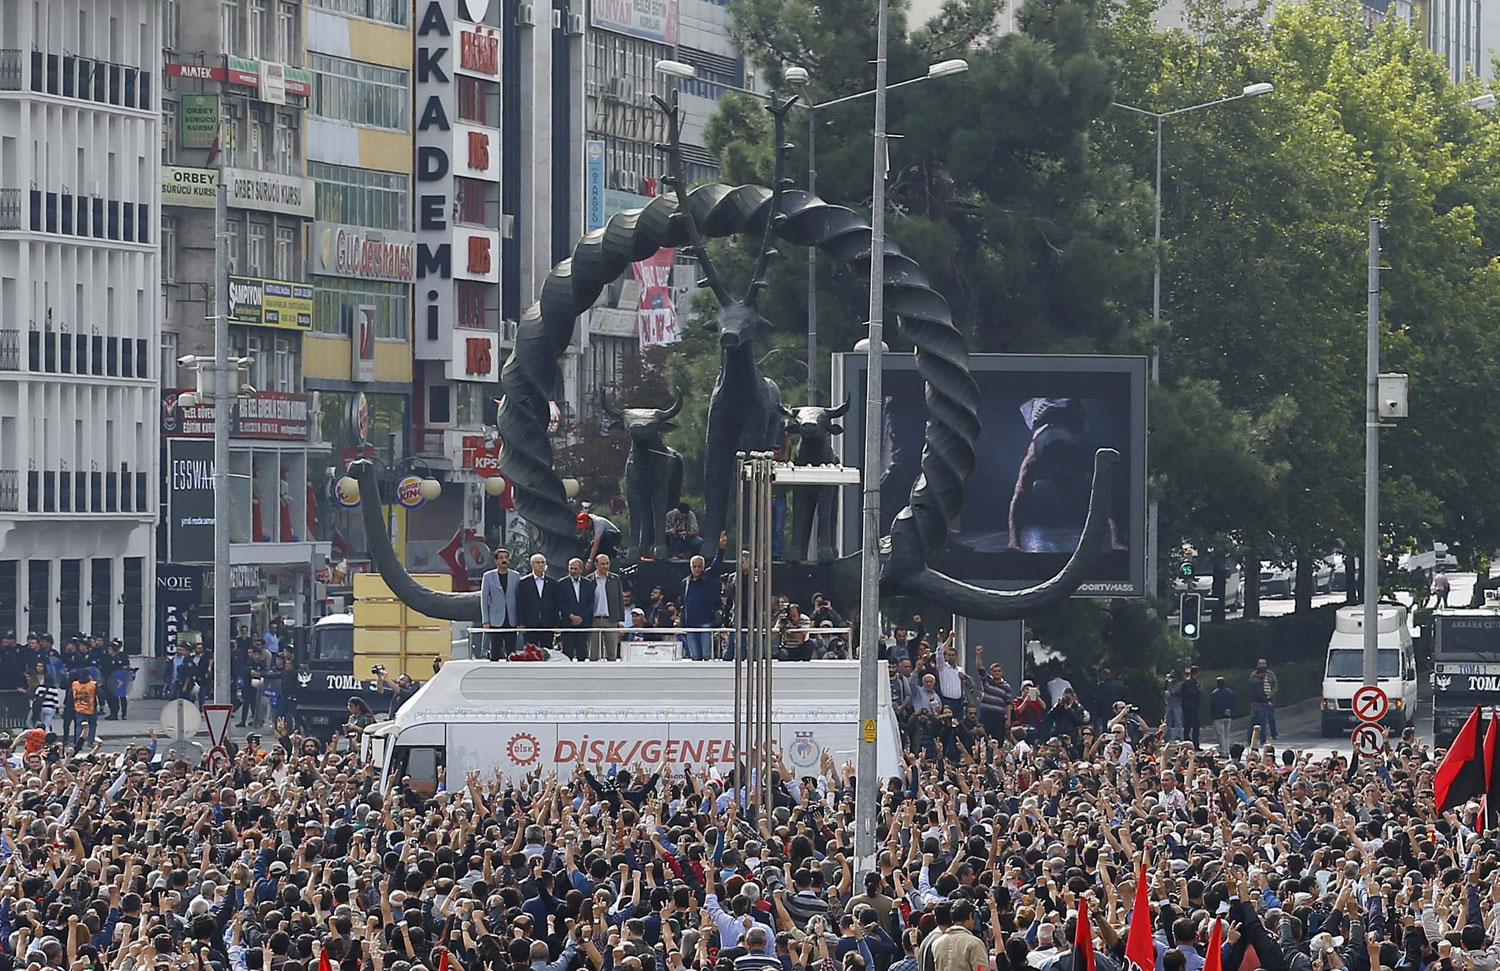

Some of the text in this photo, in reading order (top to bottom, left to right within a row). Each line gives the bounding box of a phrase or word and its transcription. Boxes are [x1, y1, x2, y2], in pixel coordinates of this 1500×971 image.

[173, 171, 215, 184] ORBEY
[161, 184, 192, 195] SÜRÜCÜ
[234, 178, 256, 199] ORBEY
[255, 178, 280, 202] SÜRÜCÜ
[157, 577, 192, 588] NOTE
[326, 674, 362, 691] TOMA
